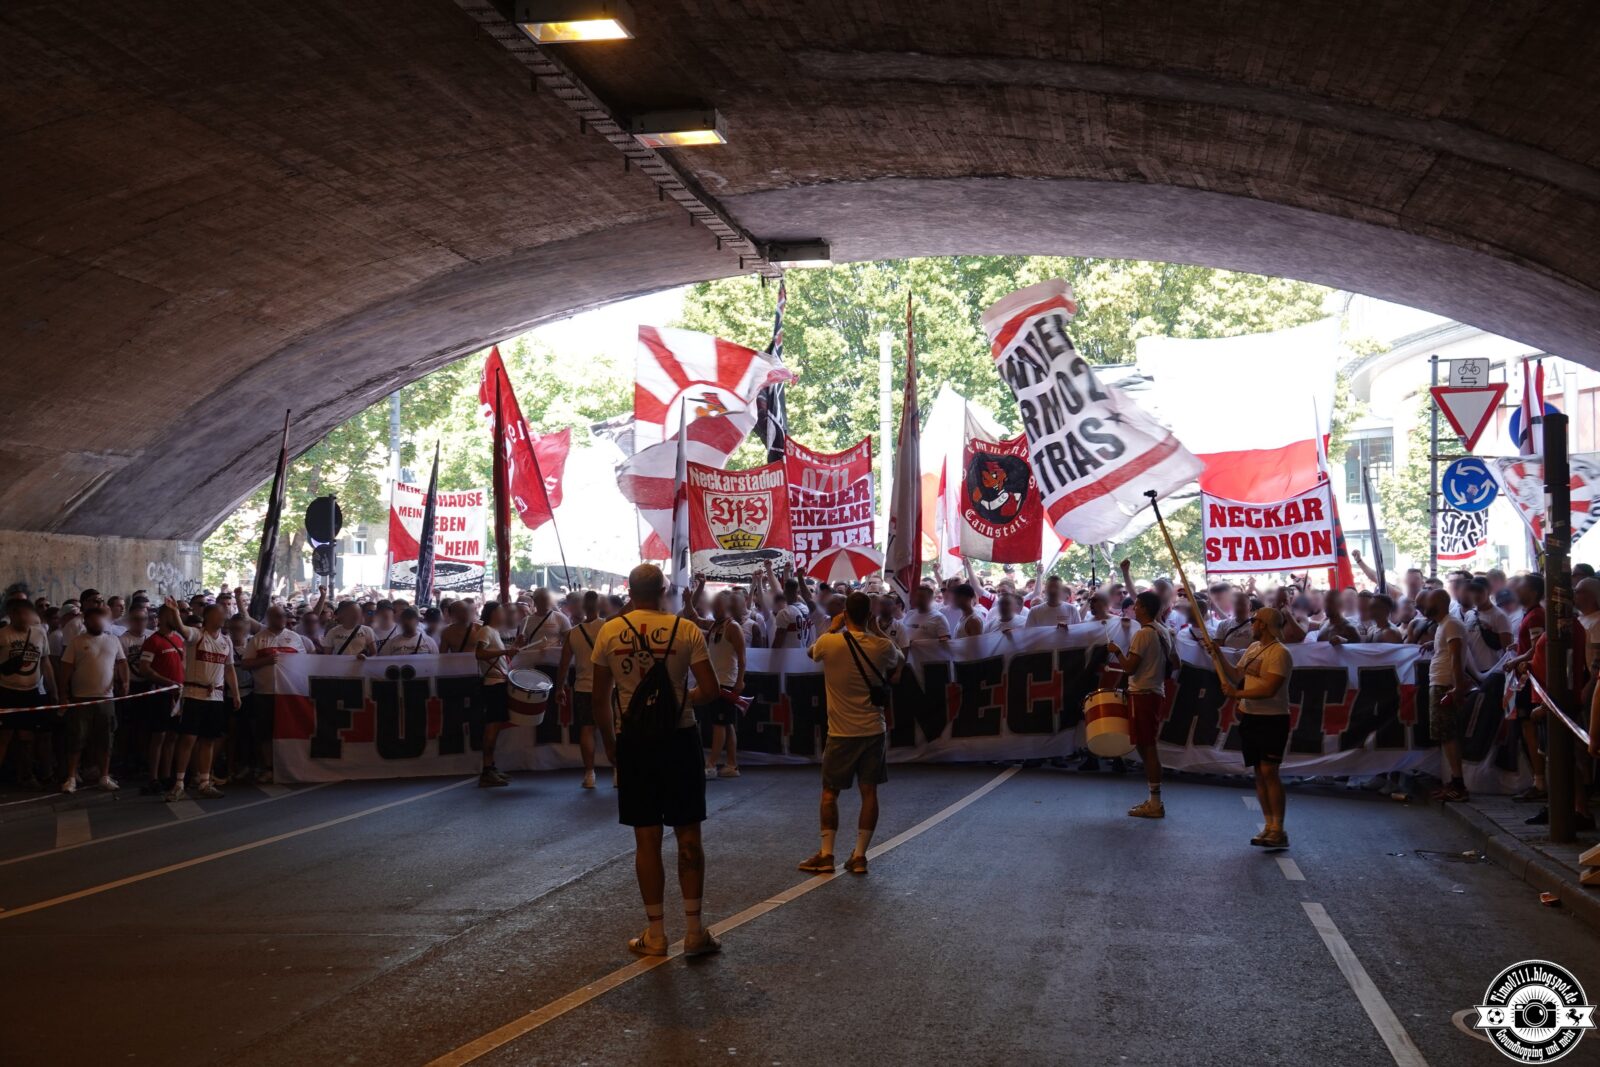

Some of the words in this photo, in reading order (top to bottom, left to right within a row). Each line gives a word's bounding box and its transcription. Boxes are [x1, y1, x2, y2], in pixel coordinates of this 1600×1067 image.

[1034, 417, 1126, 502] TRAS
[689, 467, 784, 492] Neckarstadion
[421, 491, 483, 507] ZHAUSE
[398, 506, 423, 518] MEIN
[433, 516, 466, 531] EBEN
[790, 501, 871, 527] EINZELNE
[1209, 497, 1324, 528] NECKAR
[444, 540, 480, 556] HEIM
[1205, 530, 1332, 562] STADION
